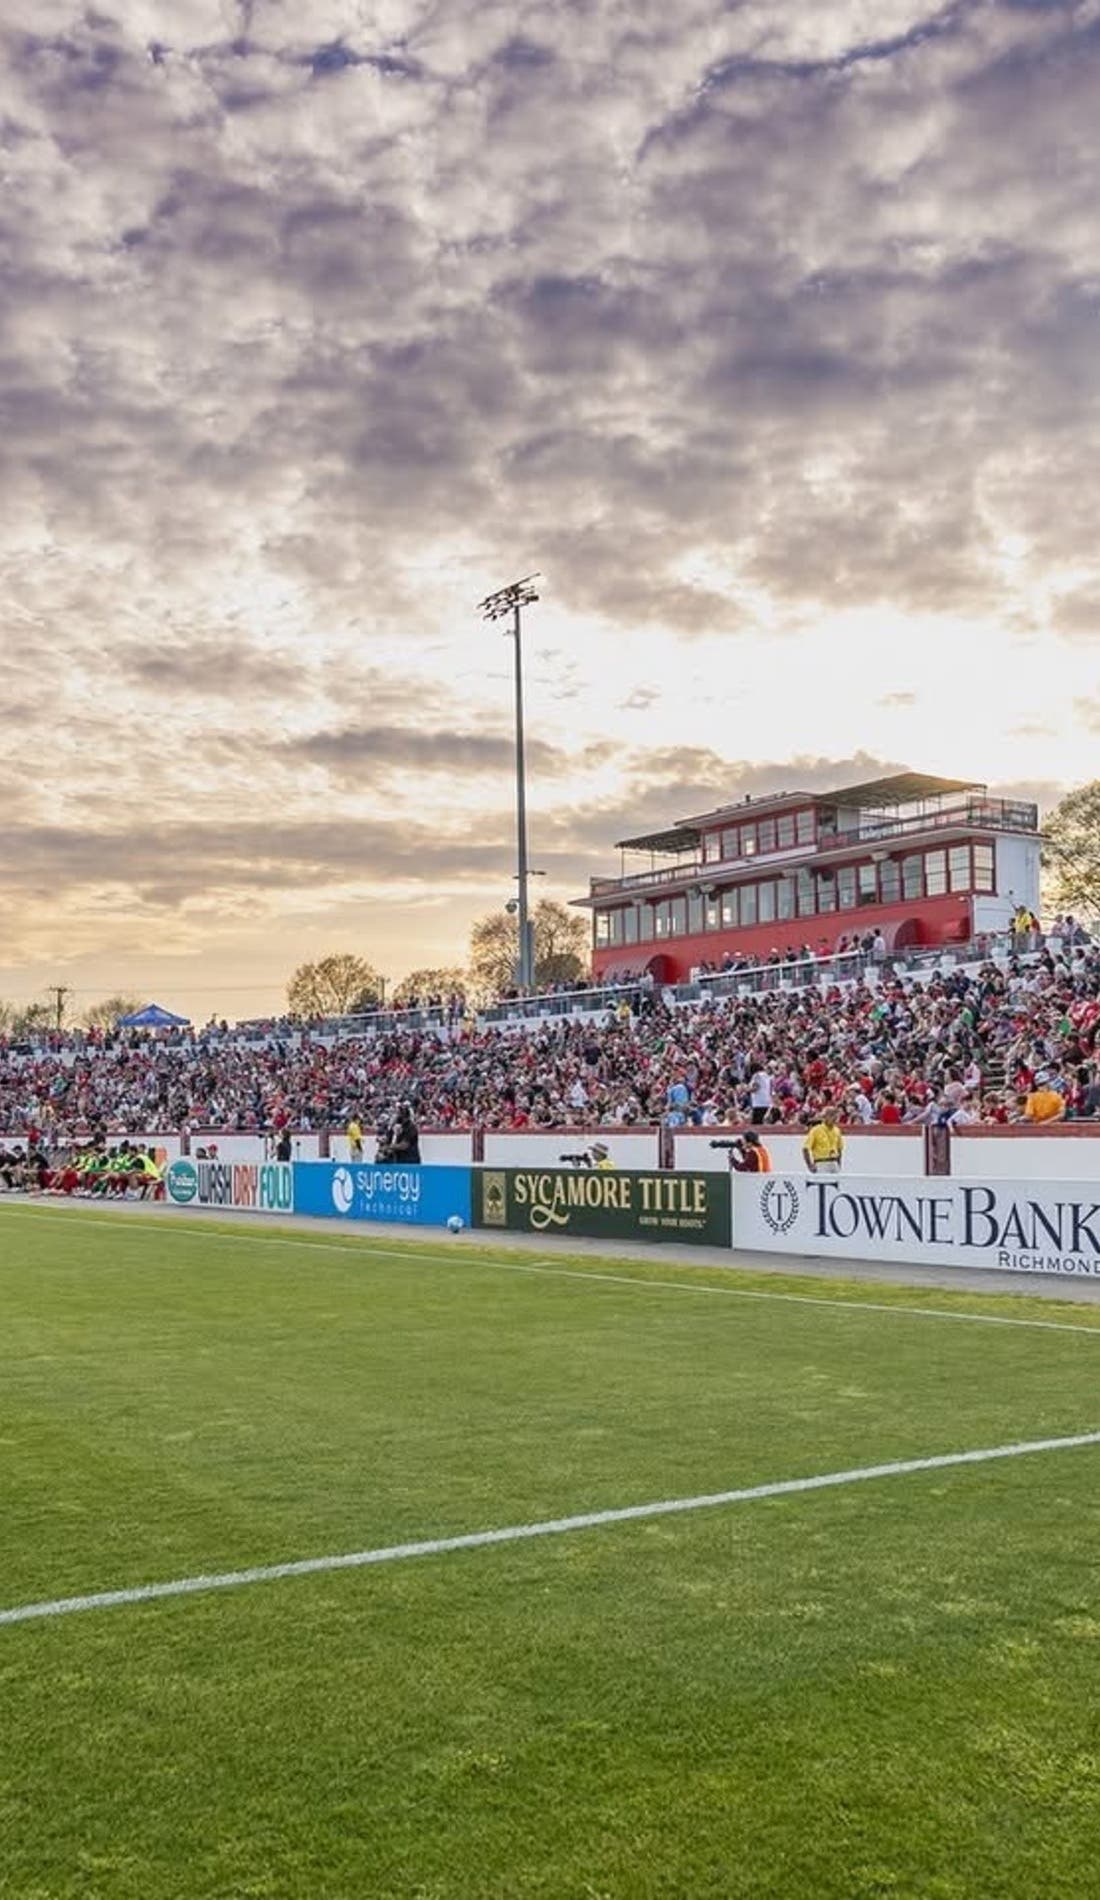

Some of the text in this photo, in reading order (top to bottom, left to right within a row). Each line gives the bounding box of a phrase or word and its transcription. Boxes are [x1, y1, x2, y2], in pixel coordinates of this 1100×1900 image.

[234, 1164, 258, 1206] DRY
[260, 1166, 291, 1209] FOLD
[357, 1171, 420, 1201] synergy
[359, 1199, 418, 1216] technical
[514, 1174, 707, 1229] SYCAMORE TITLE
[771, 1193, 789, 1221] T
